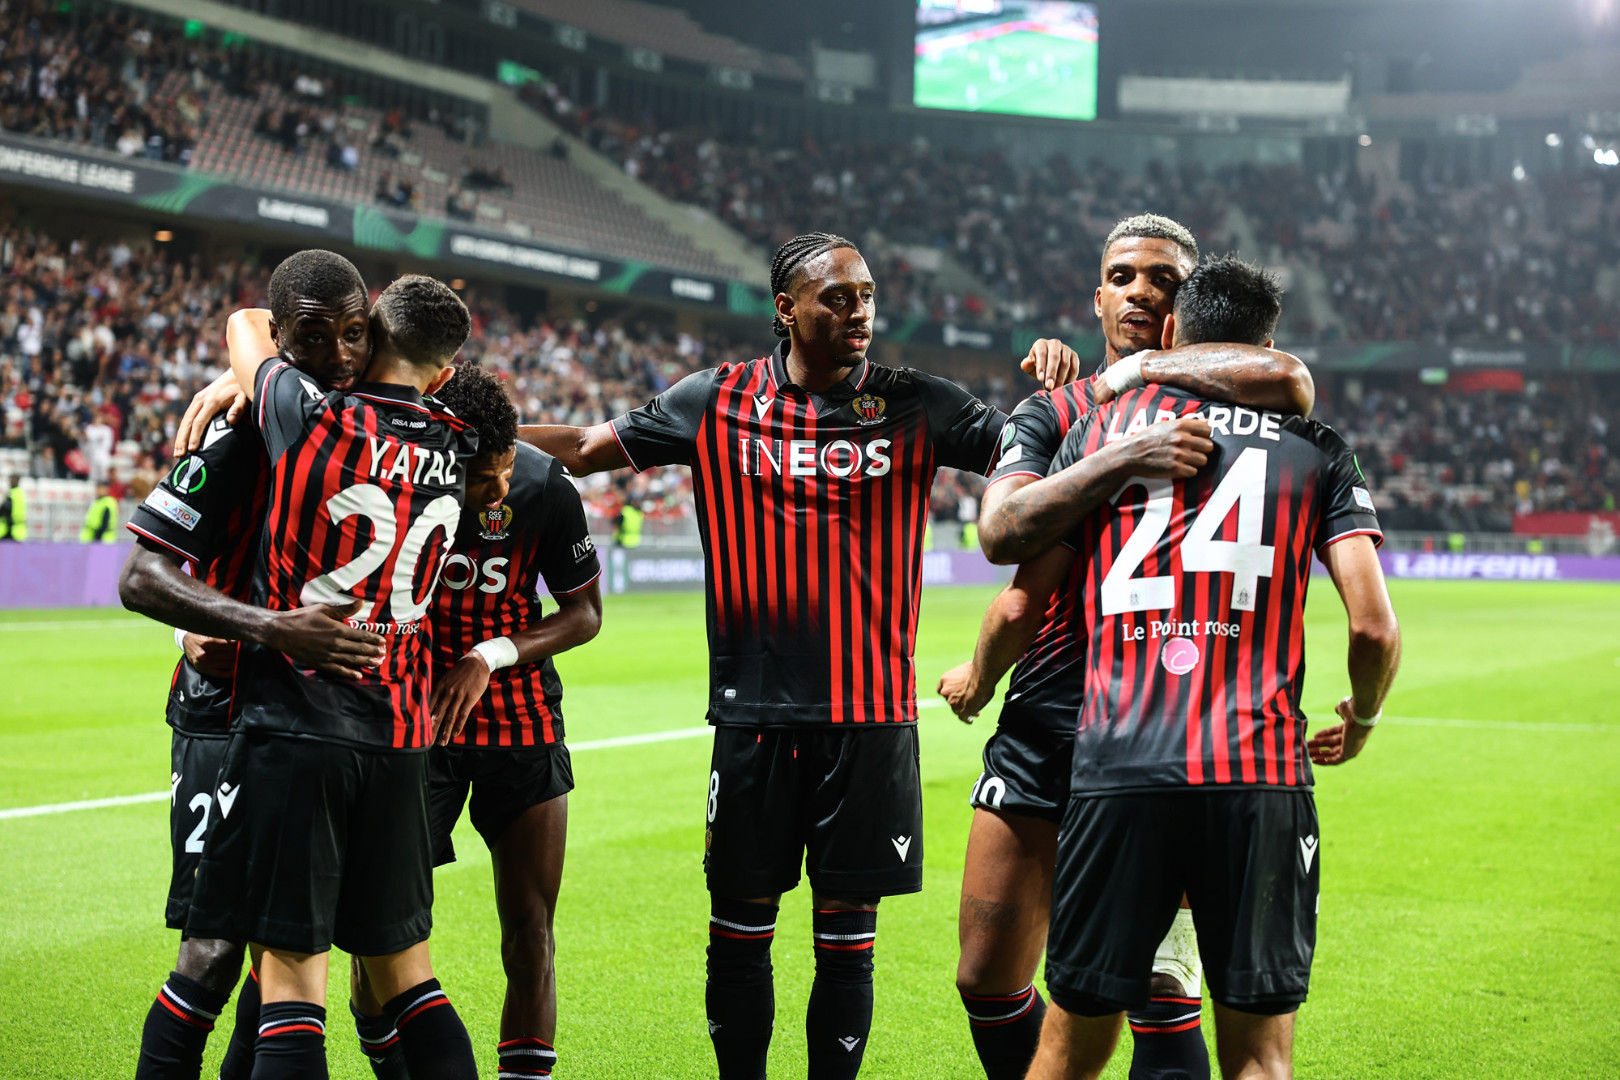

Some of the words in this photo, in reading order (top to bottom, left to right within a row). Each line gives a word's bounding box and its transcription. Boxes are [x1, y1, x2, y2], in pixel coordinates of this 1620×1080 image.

[80, 162, 135, 194] LEAGUE
[391, 418, 408, 427] ISSA
[369, 436, 457, 485] Y.ATAL
[739, 438, 892, 477] INEOS
[300, 483, 461, 623] 20
[1101, 447, 1275, 616] 24
[1392, 553, 1558, 579] Laurenn
[1122, 623, 1145, 641] Le
[1150, 618, 1200, 638] Point
[1204, 620, 1240, 637] rose
[707, 770, 720, 823] 8
[185, 792, 212, 853] 2
